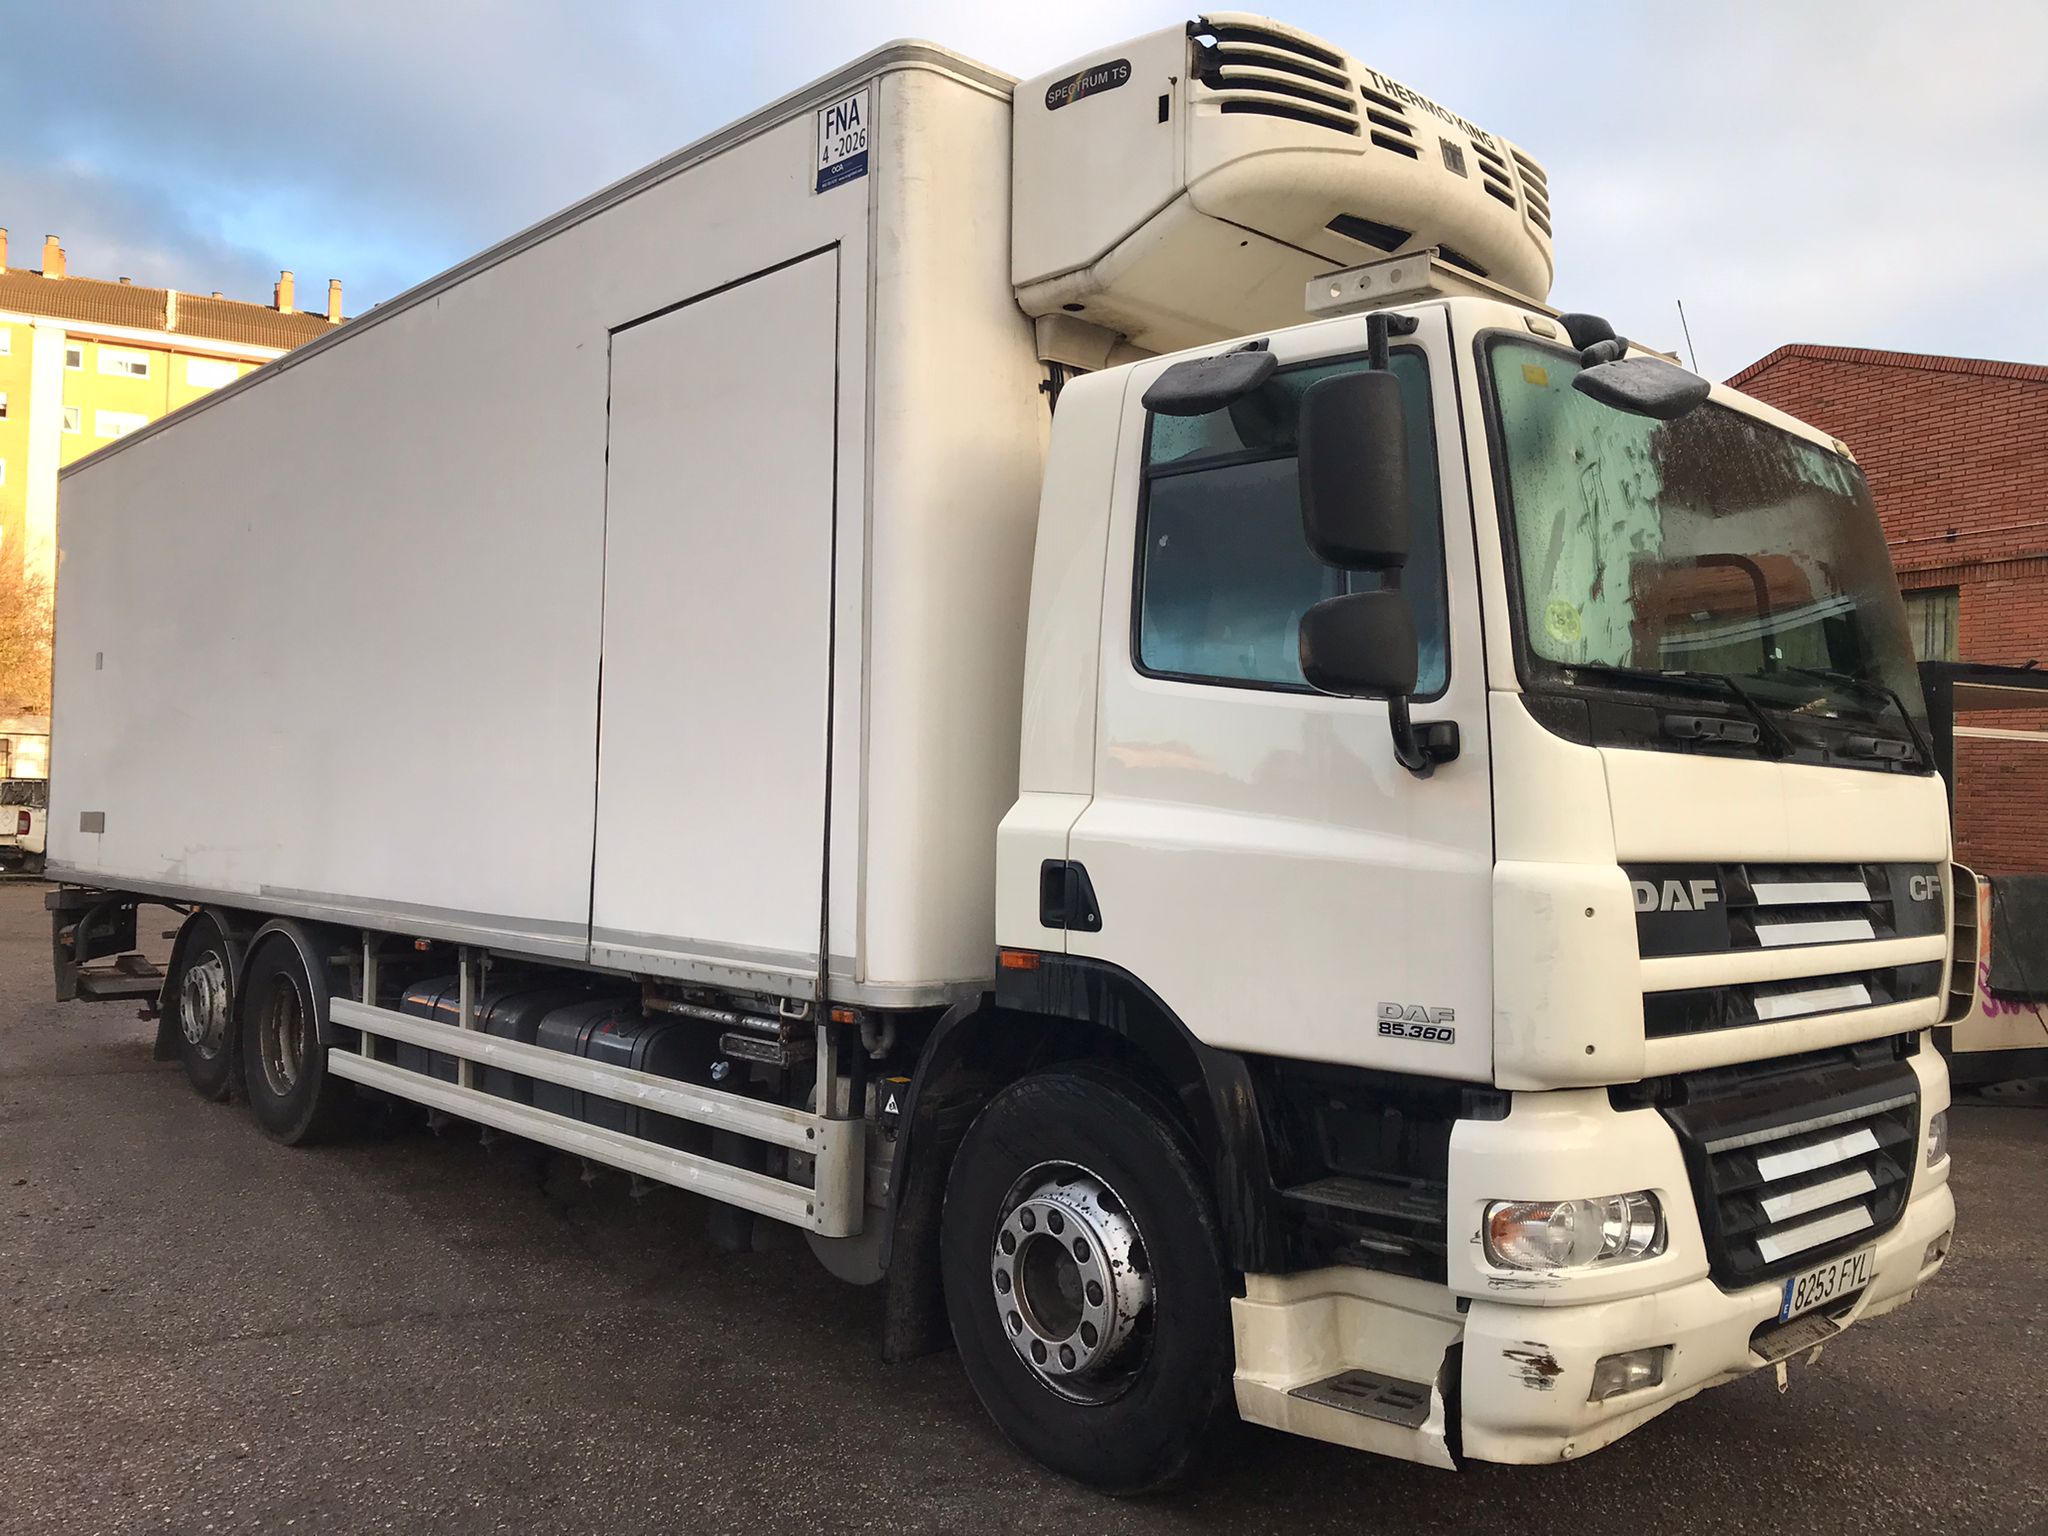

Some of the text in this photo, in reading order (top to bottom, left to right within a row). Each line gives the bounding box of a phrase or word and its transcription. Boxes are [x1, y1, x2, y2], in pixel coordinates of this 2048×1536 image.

[1048, 65, 1127, 104] SPECTRUM TS
[826, 98, 860, 140] FNA
[1365, 67, 1497, 151] THERMO KING
[1631, 880, 1720, 912] DAF
[1909, 875, 1941, 901] CF
[1377, 1001, 1455, 1024] DAF
[1378, 1022, 1453, 1042] 85.360
[1794, 1265, 1837, 1311] 8253
[1838, 1253, 1867, 1293] FYL
